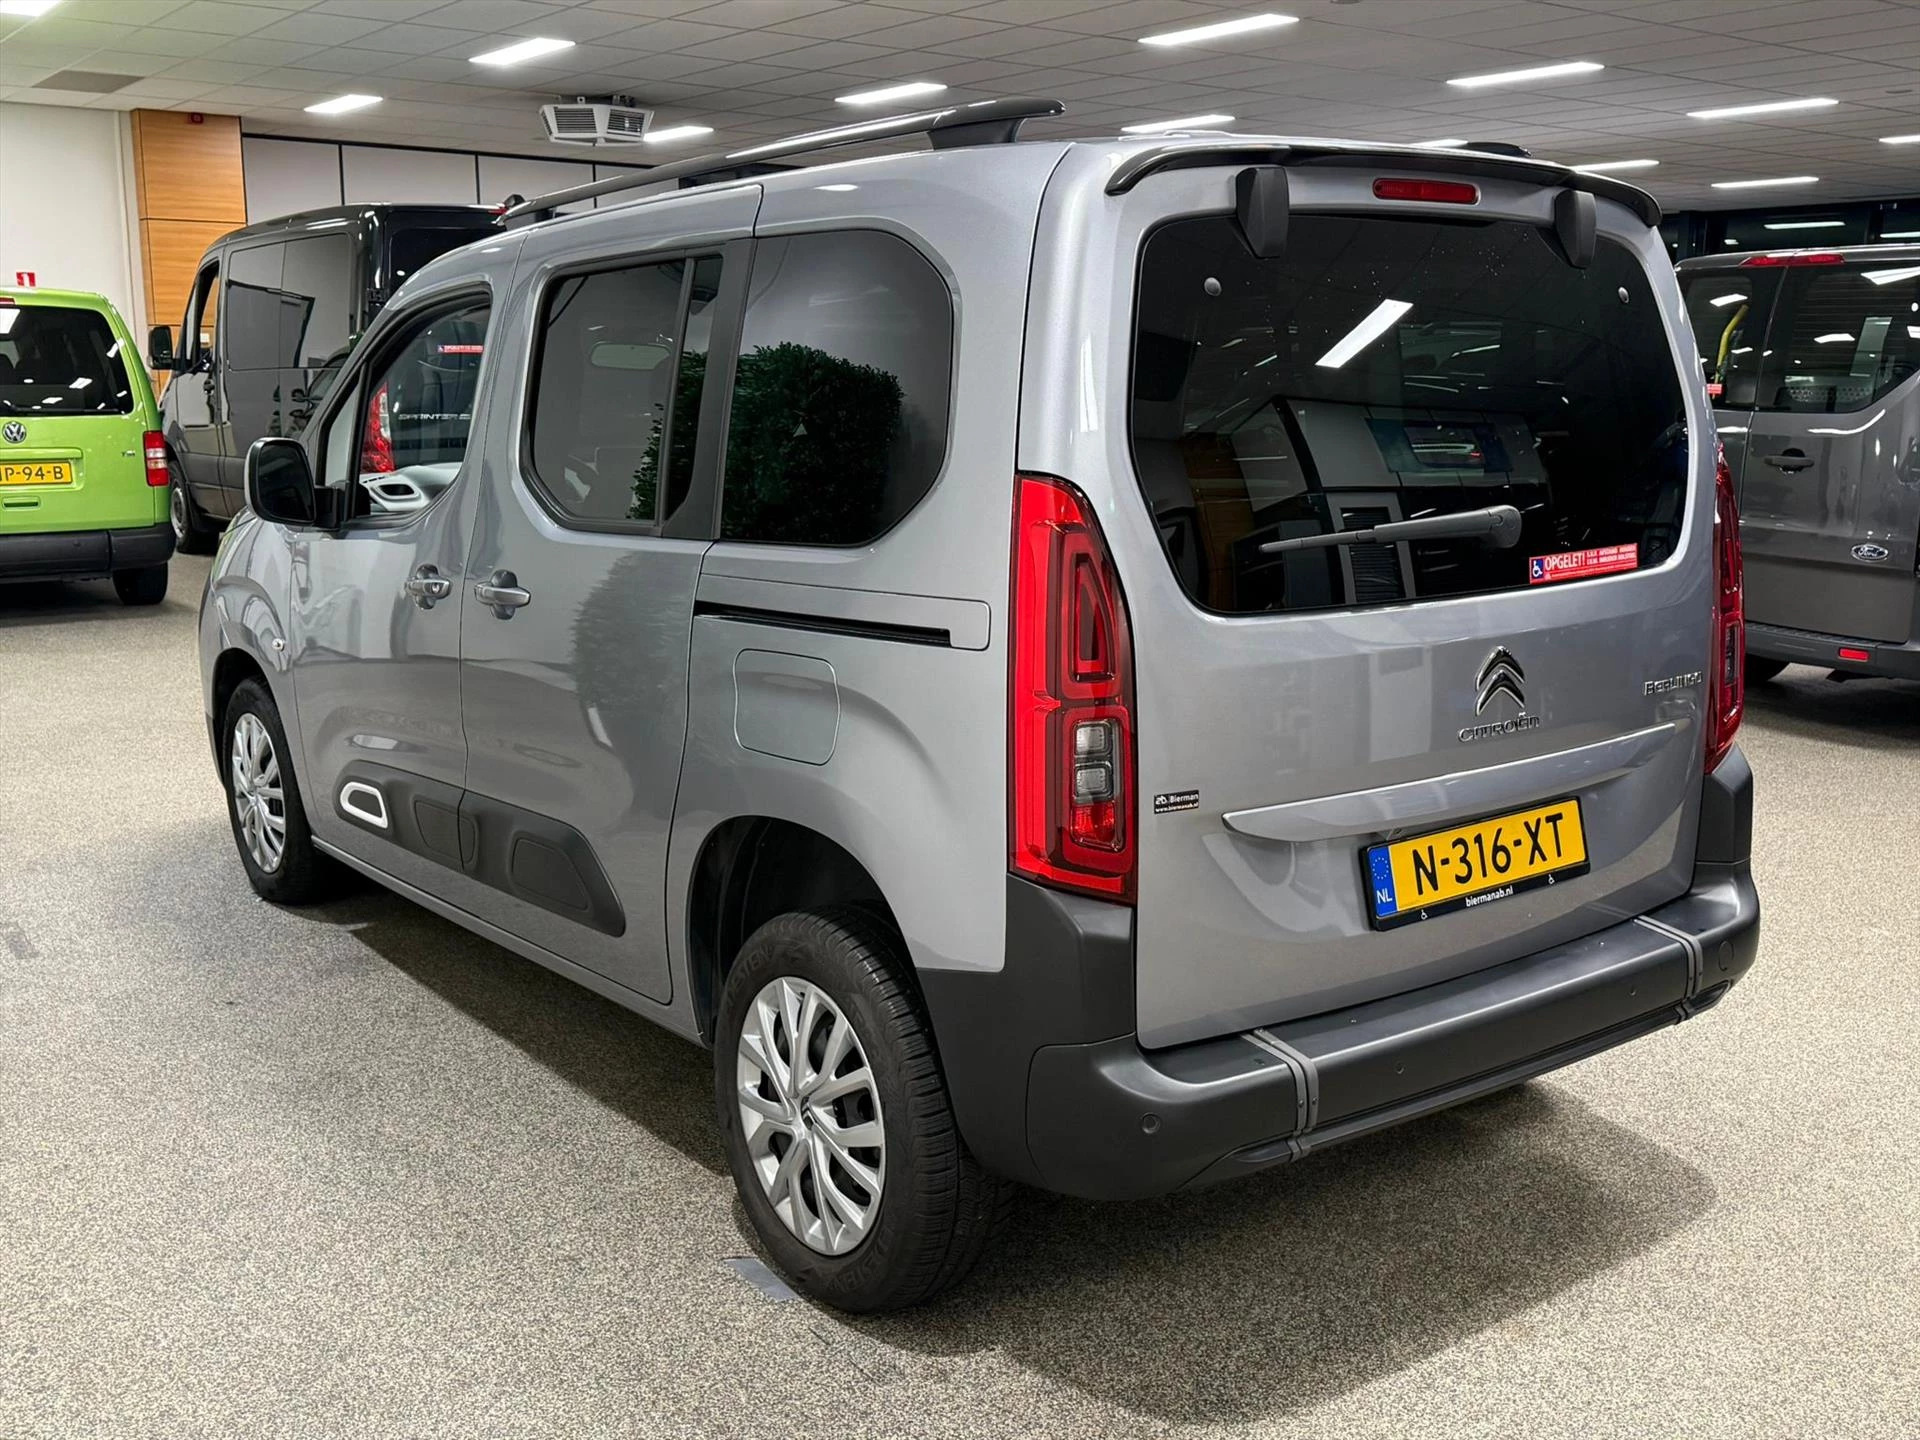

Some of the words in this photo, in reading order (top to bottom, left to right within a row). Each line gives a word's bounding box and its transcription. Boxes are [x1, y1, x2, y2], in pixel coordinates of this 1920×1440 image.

[1544, 550, 1586, 571] OPGELET!
[1411, 812, 1564, 896] N-316-XT
[1376, 887, 1393, 905] NL
[1465, 884, 1514, 908] biermanab.nl
